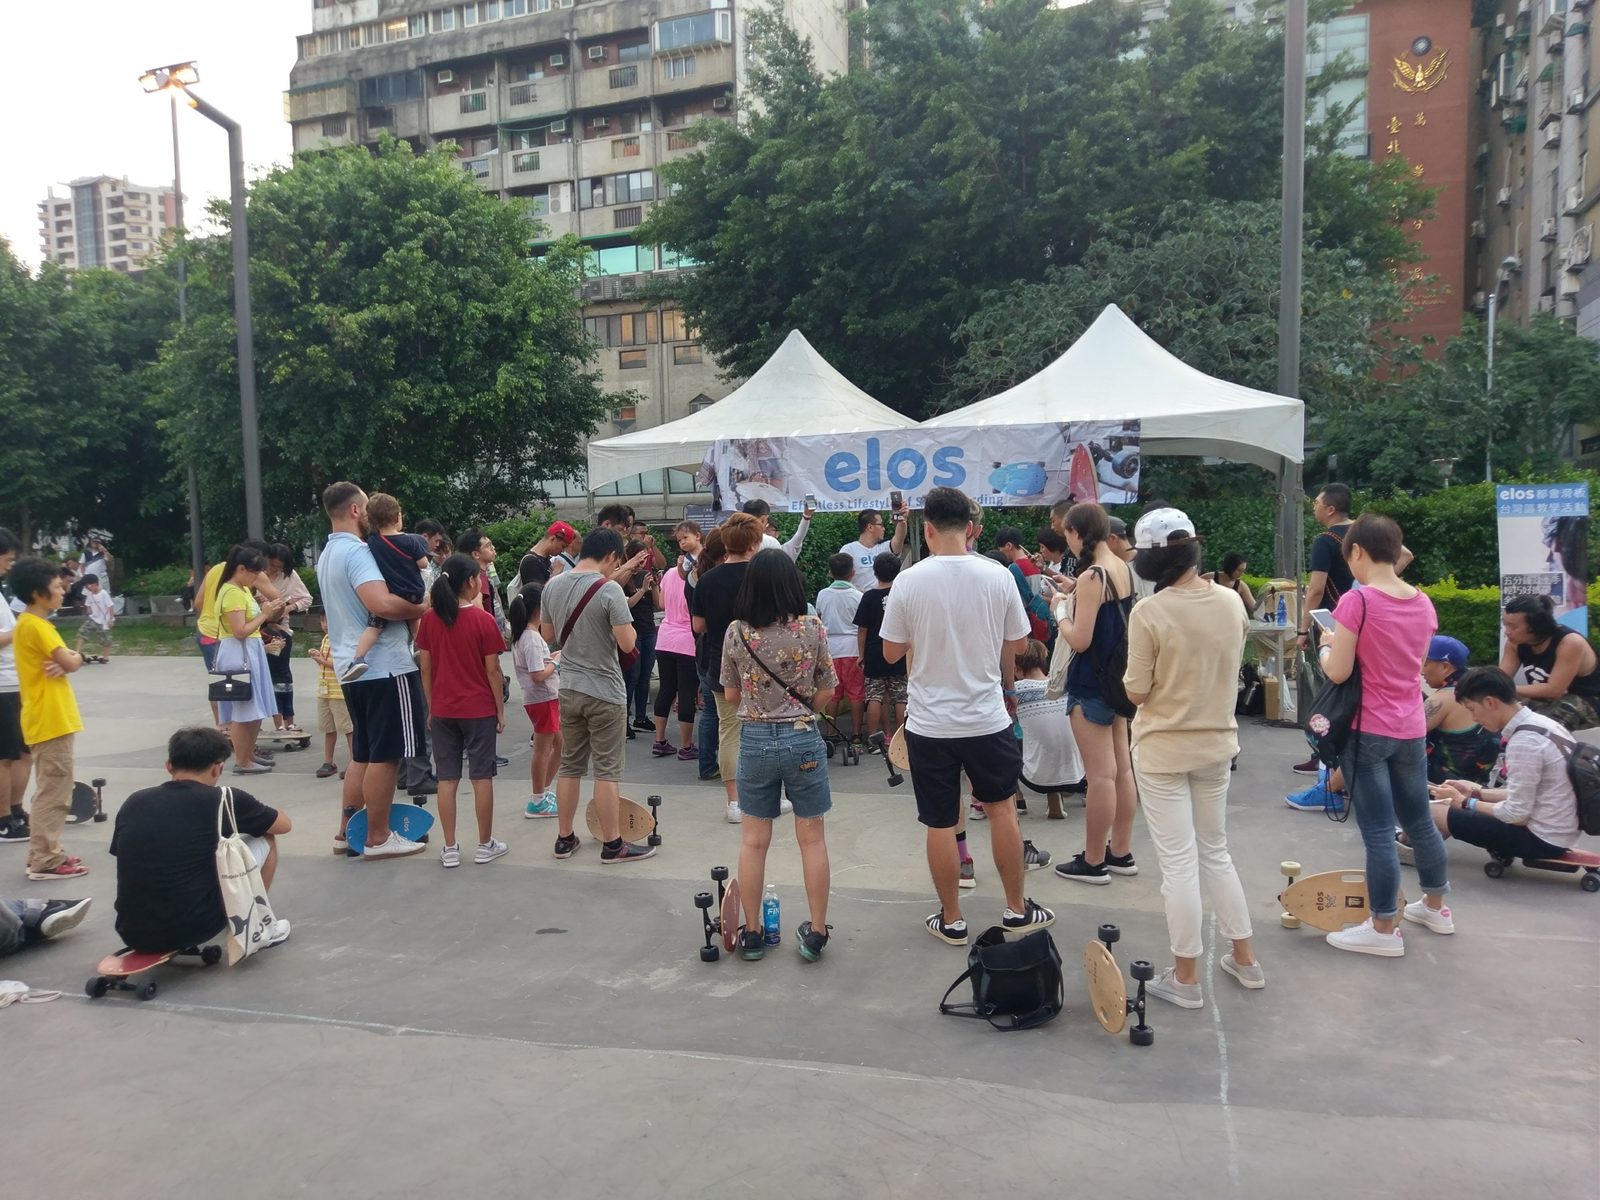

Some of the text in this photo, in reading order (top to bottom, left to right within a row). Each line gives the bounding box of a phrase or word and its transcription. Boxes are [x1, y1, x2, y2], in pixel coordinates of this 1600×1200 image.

[824, 437, 966, 492] elos
[1499, 487, 1535, 500] elos
[791, 499, 843, 511] Eftless
[847, 496, 890, 510] Lifestyl
[1316, 891, 1325, 912] elos
